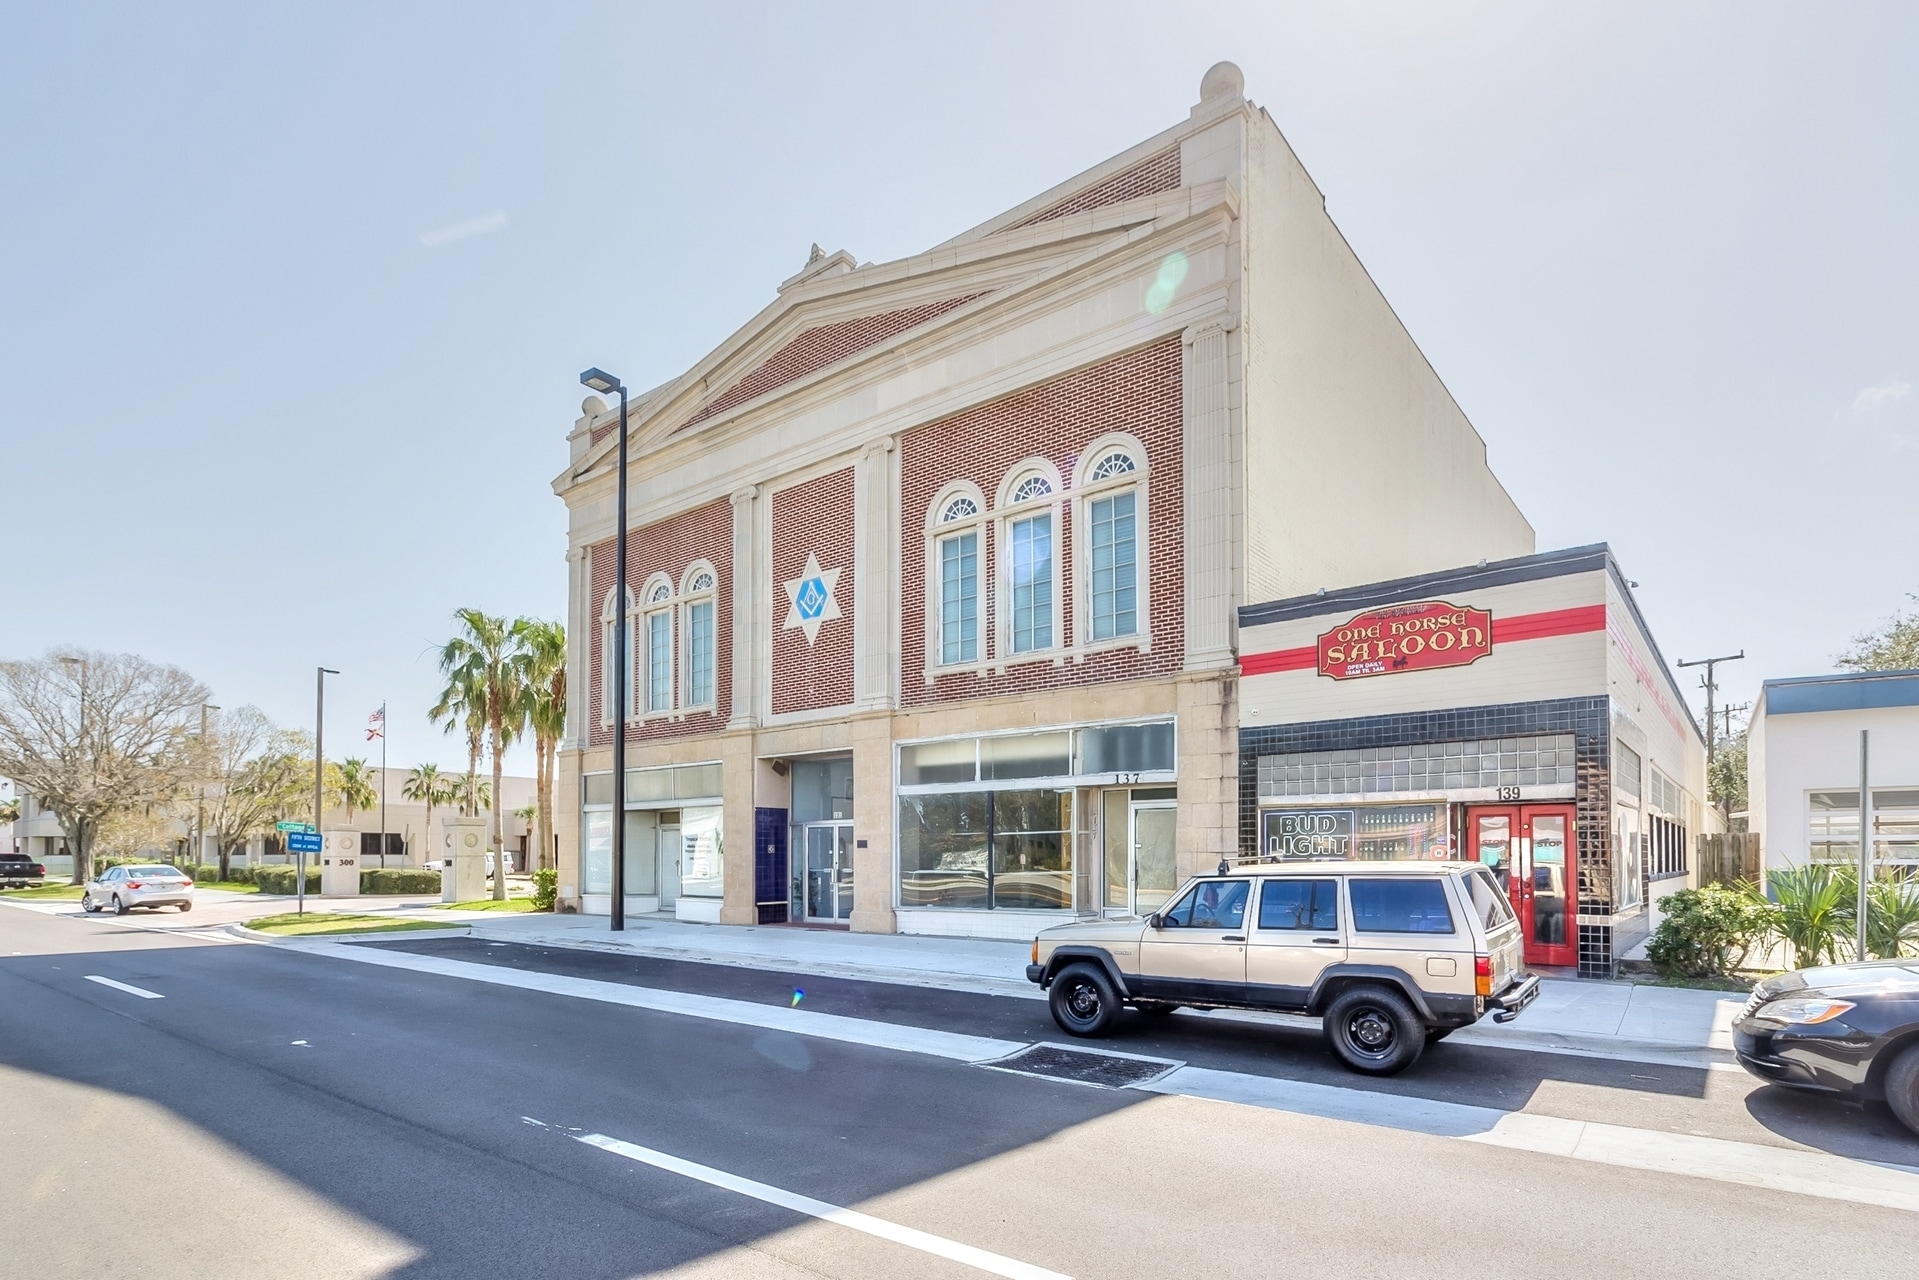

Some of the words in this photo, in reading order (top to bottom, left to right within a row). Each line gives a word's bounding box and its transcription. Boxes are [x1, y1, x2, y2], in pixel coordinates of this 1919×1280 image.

[1337, 622, 1382, 643] ONE
[1390, 609, 1468, 636] HORSE
[1322, 627, 1486, 670] SALOON
[1347, 663, 1364, 671] OPEN
[1365, 660, 1383, 669] DAILY
[1114, 773, 1140, 785] 137
[1496, 786, 1521, 801] 139
[1280, 814, 1337, 835] BUD
[1269, 834, 1348, 857] LIGHT
[1536, 839, 1563, 848] STOP
